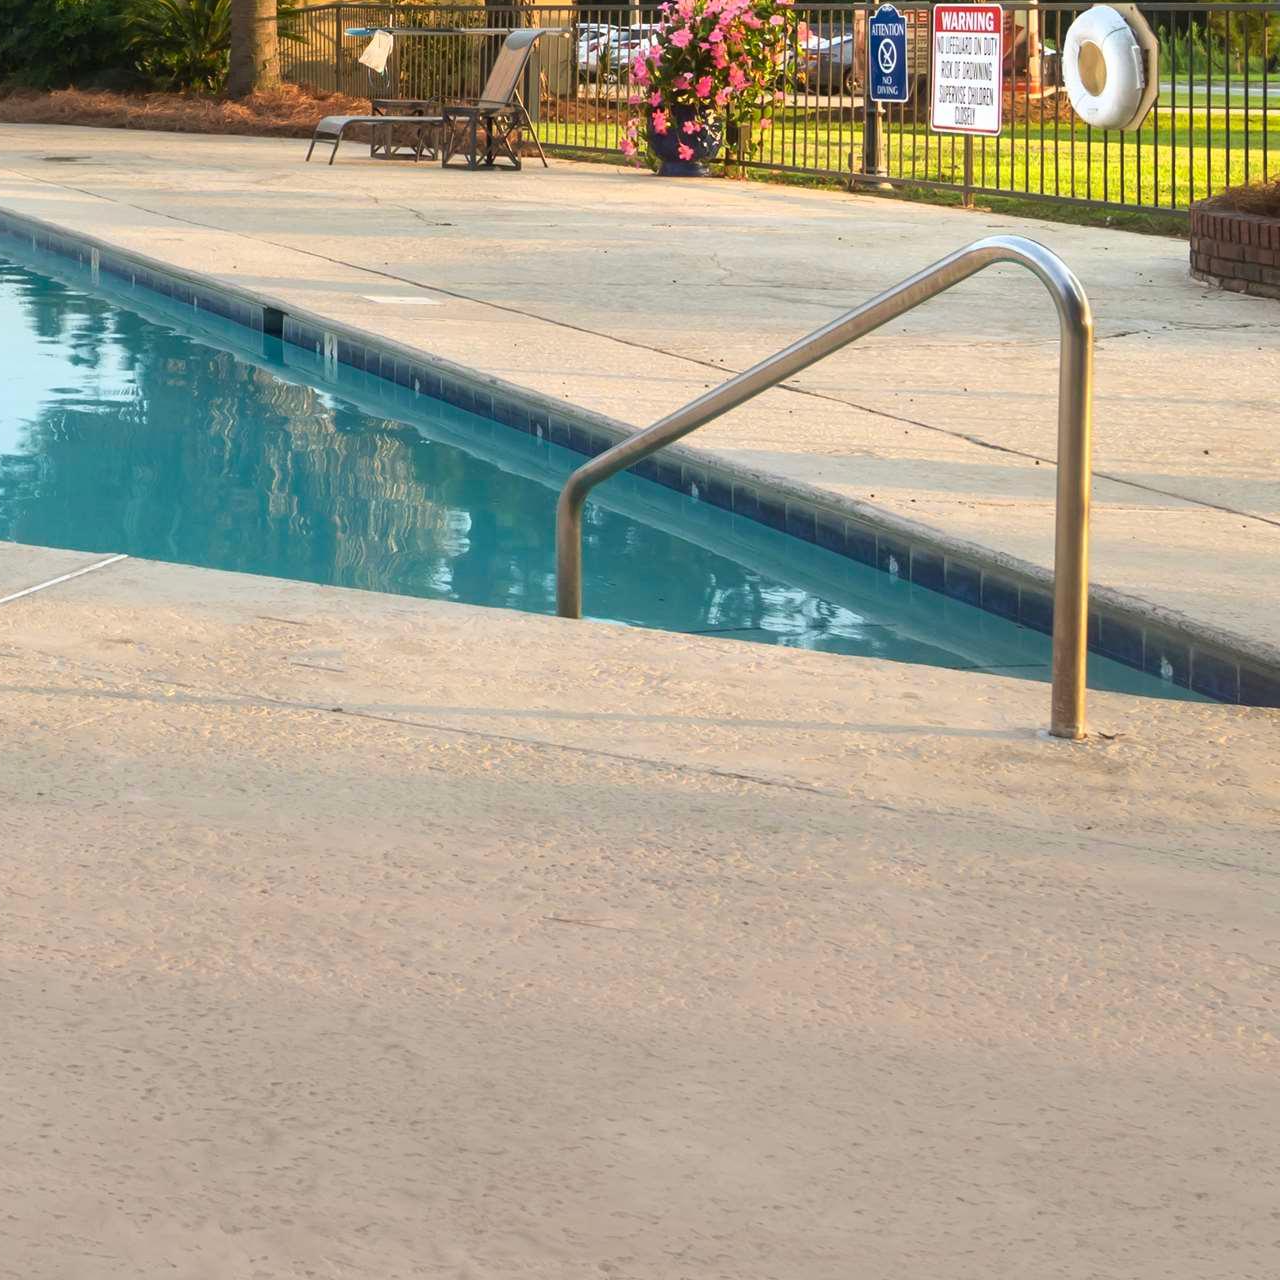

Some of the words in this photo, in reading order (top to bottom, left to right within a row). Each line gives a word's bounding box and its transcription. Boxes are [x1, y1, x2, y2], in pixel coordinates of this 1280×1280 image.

[872, 23, 904, 36] ATTENTION
[941, 11, 994, 31] WARNING
[937, 35, 944, 54] NO
[946, 36, 972, 55] LIFEGUARD
[974, 37, 982, 56] ON
[984, 37, 997, 56] DUTY
[941, 60, 952, 78] RISK
[954, 61, 960, 79] OF
[963, 61, 992, 81] DROWNING
[877, 85, 899, 95] DIVING
[881, 76, 893, 85] NO
[939, 85, 966, 105] SUPERVISE
[968, 86, 994, 106] CHILDREN
[954, 106, 975, 125] CLOSELY
